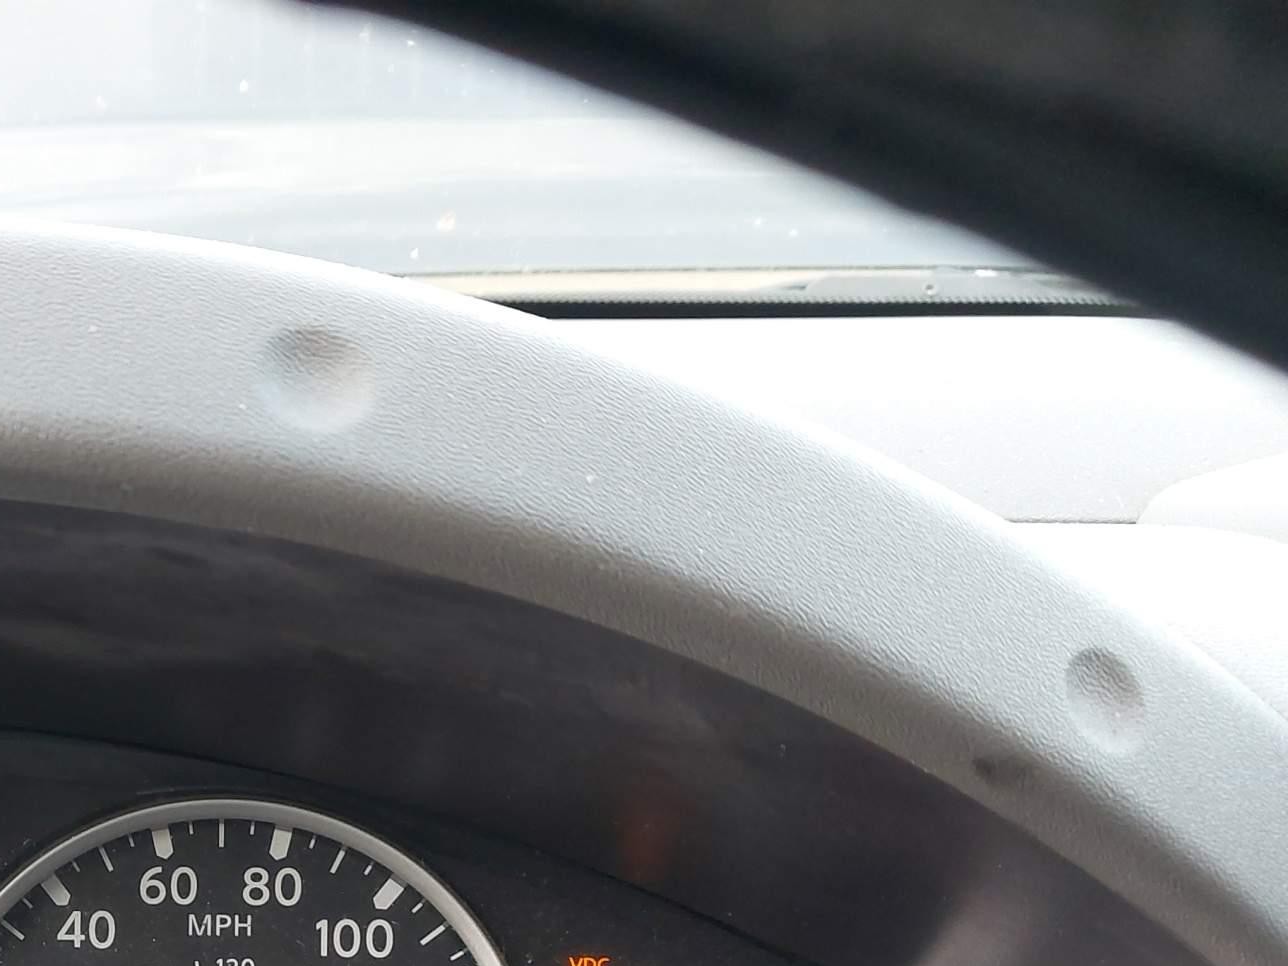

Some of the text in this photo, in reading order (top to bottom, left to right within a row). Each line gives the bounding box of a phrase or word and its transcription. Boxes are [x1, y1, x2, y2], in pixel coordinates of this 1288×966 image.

[140, 867, 197, 904] 60
[243, 868, 301, 906] 80
[57, 911, 115, 948] 40
[189, 915, 251, 936] MPH
[316, 919, 393, 958] 100
